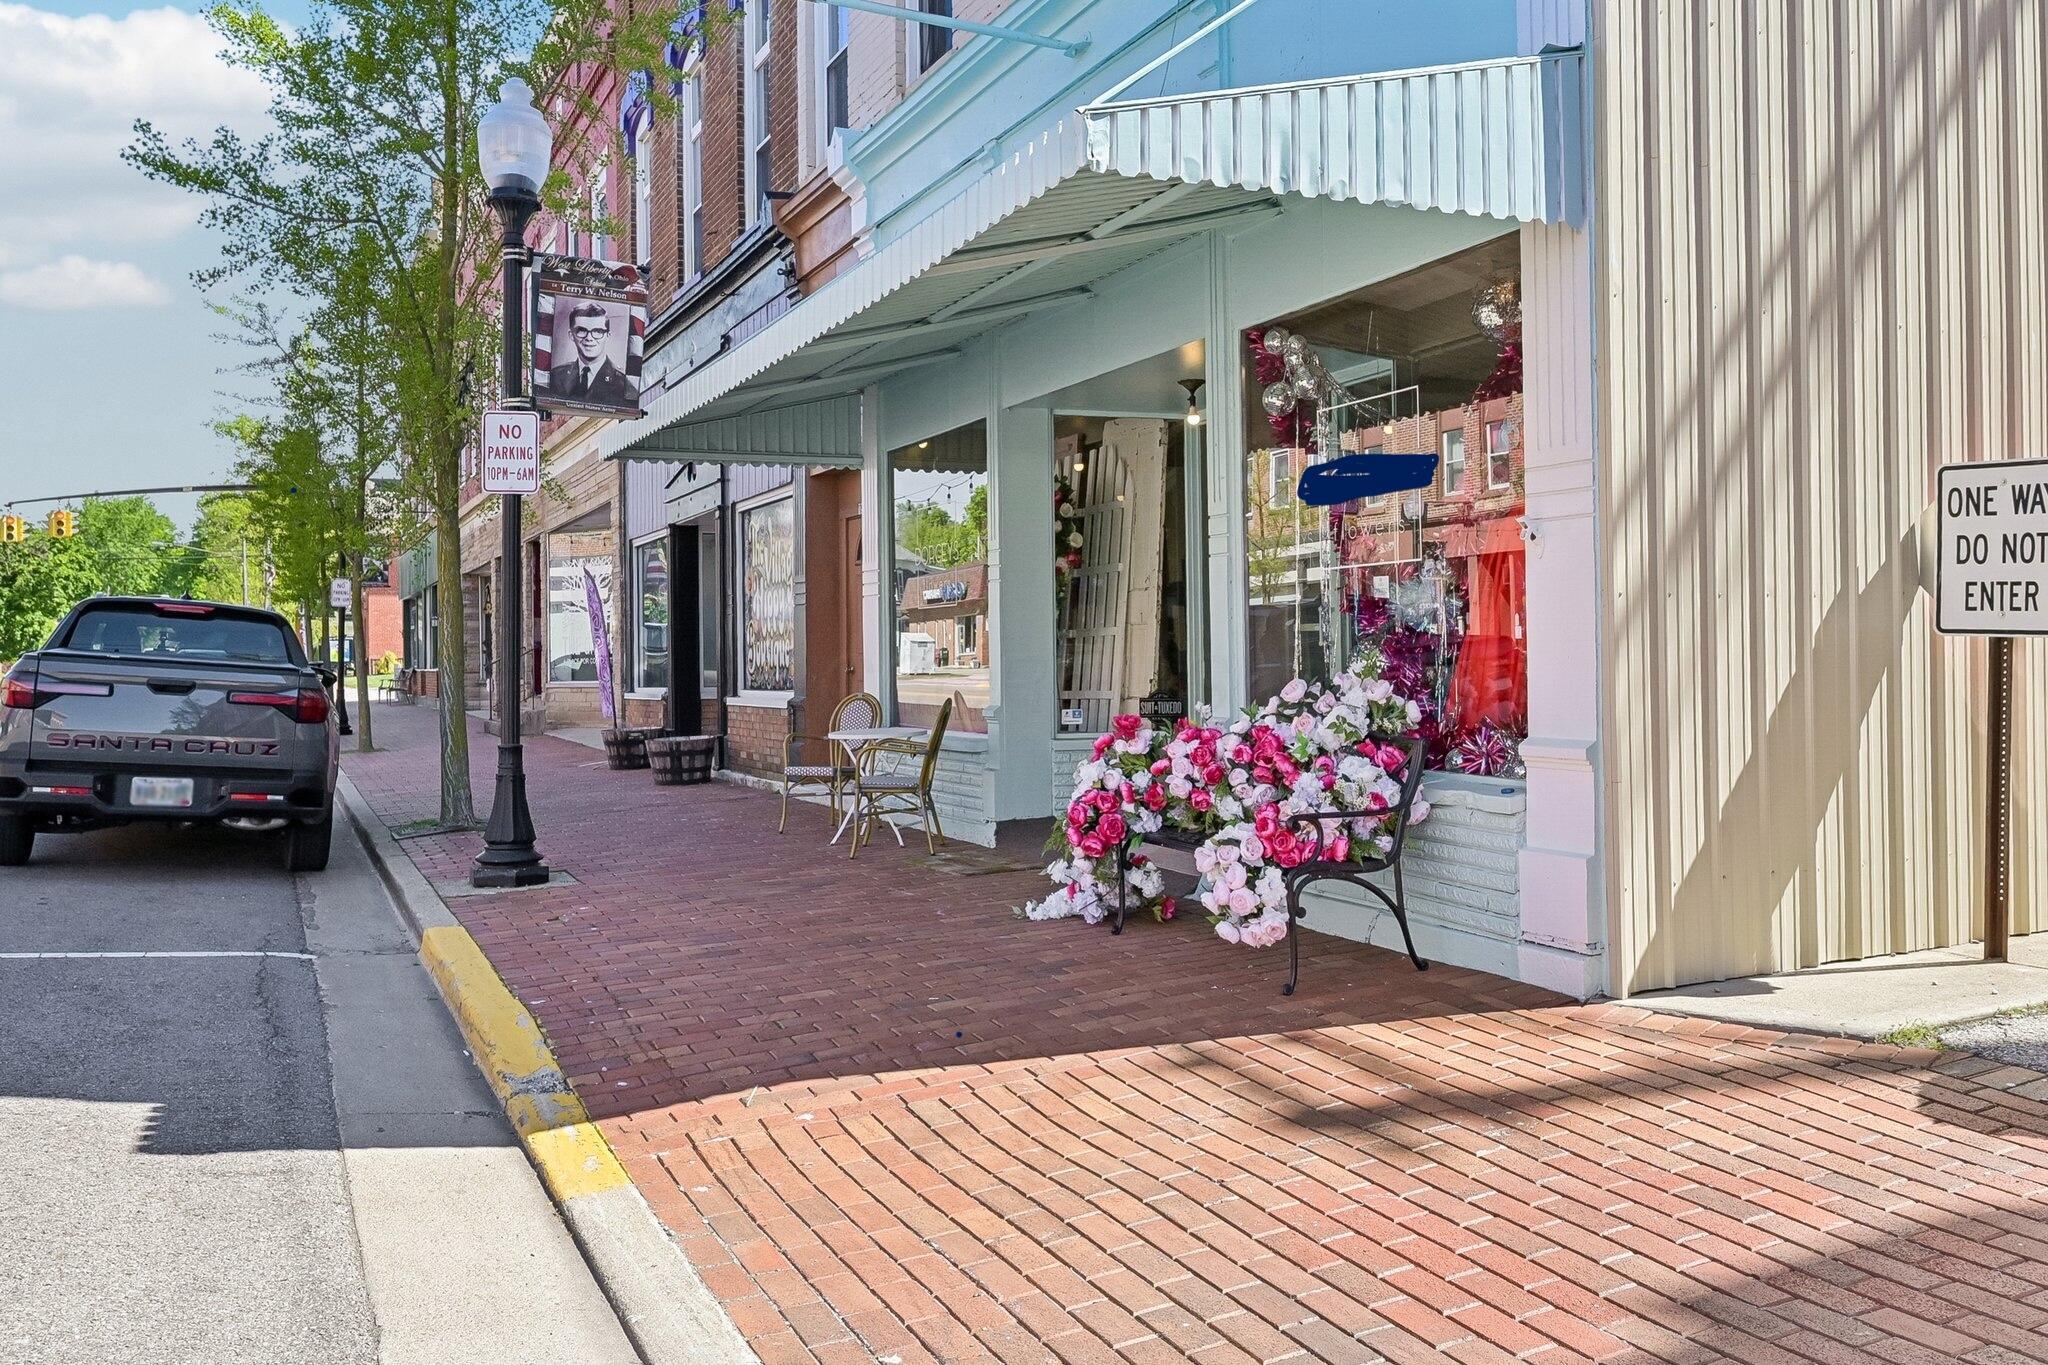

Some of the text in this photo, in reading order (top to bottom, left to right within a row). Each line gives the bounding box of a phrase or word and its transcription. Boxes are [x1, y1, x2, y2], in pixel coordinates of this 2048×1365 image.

[542, 255, 571, 268] West
[560, 284, 582, 295] Terry
[585, 286, 597, 295] W.
[599, 288, 627, 299] Nelson
[602, 406, 616, 414] Army
[499, 424, 522, 439] NO
[487, 446, 533, 460] PARKING
[1947, 486, 1998, 518] ONE
[748, 519, 764, 567] The
[1956, 532, 2048, 565] DO NOT
[1965, 581, 2039, 612] ENTER
[746, 620, 791, 682] Boutique
[1140, 701, 1155, 714] SUIT
[1158, 701, 1182, 714] TUXEDO
[47, 732, 281, 758] SANTA CRUZ
